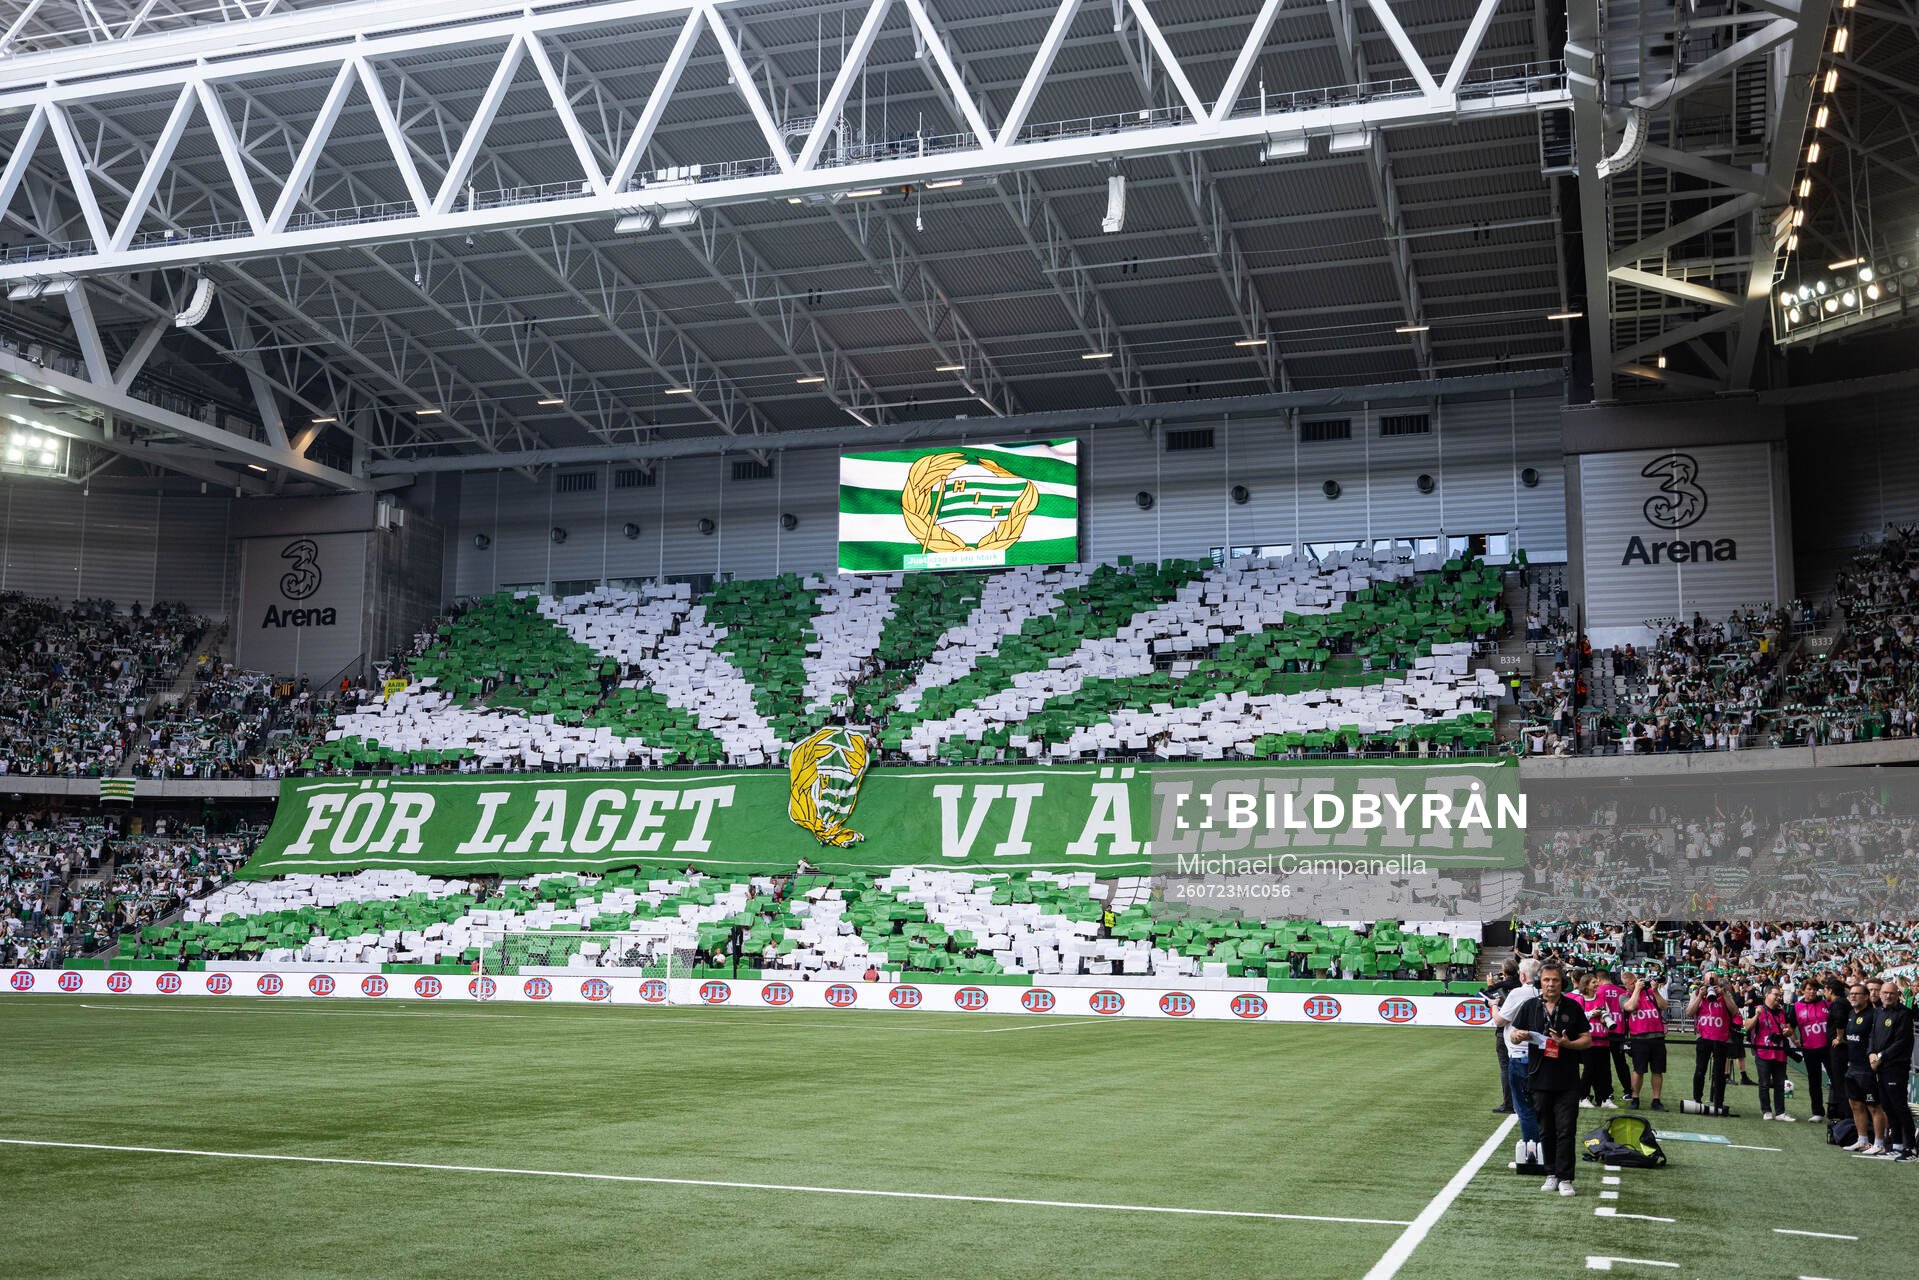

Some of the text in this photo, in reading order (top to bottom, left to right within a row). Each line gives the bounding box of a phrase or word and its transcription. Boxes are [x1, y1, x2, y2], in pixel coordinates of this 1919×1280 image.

[1641, 453, 1709, 530] 3
[1621, 535, 1737, 566] Arena
[280, 539, 322, 600] 3
[262, 604, 337, 629] Arena
[1811, 637, 1833, 646] B333
[1500, 656, 1520, 664] B334
[282, 780, 436, 855] FÖR
[455, 785, 736, 855] LAGET
[933, 783, 1044, 857] VI
[12, 974, 32, 988] JB
[60, 974, 81, 989] JB
[108, 975, 130, 990] JB
[158, 976, 179, 990] JB
[208, 976, 230, 991] JB
[259, 977, 281, 992] JB
[311, 978, 333, 993] JB
[364, 978, 386, 993] JB
[418, 979, 440, 994] JB
[527, 981, 550, 996] JB
[702, 985, 728, 1000] JB
[764, 986, 790, 1002] JB
[828, 987, 854, 1003] JB
[892, 989, 919, 1005] JB
[957, 991, 985, 1007] JB
[1605, 989, 1618, 998] 15
[1024, 992, 1052, 1009] JB
[1092, 993, 1121, 1011] JB
[1162, 995, 1191, 1013] JB
[1234, 997, 1263, 1015] JB
[1306, 999, 1337, 1017] JB
[1382, 1001, 1413, 1019] JB
[1698, 1015, 1723, 1028] OTO
[1804, 1022, 1827, 1036] FOT
